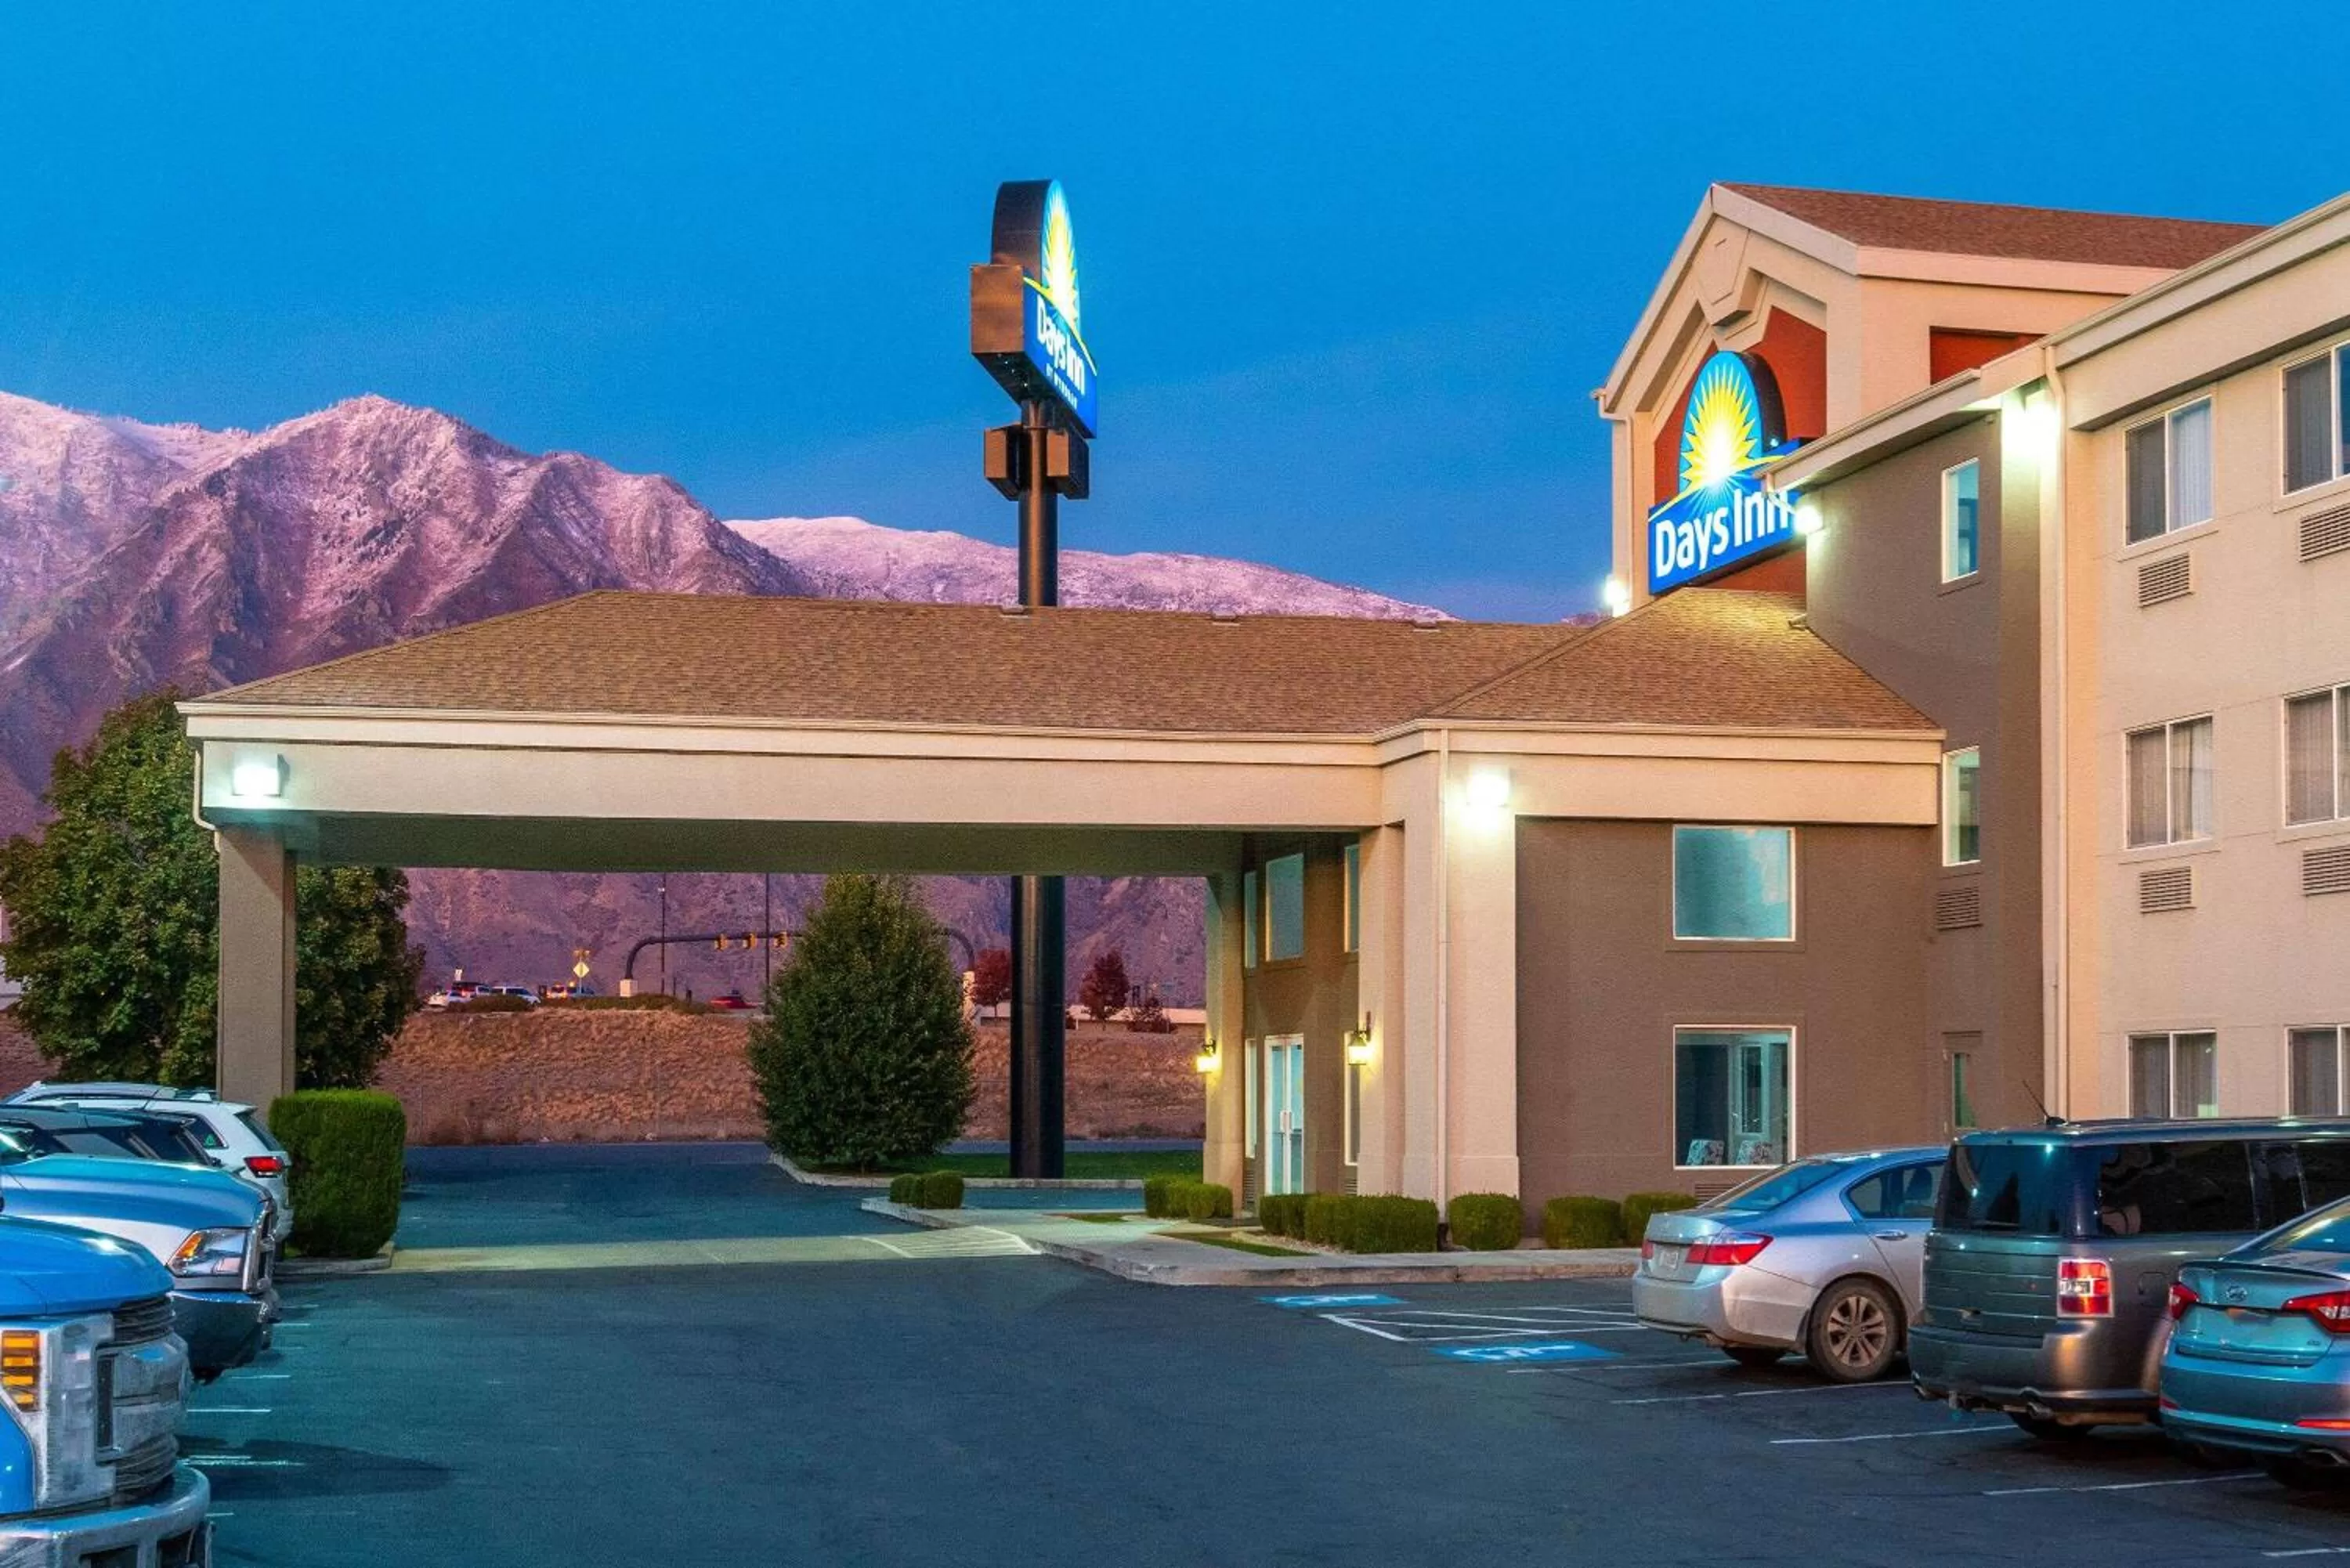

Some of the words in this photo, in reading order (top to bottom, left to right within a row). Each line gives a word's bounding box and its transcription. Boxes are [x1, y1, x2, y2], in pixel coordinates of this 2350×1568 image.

[1036, 294, 1066, 370] Days
[1066, 334, 1086, 396] Inn
[1655, 507, 1730, 578] Days
[1734, 488, 1789, 547] Inn
